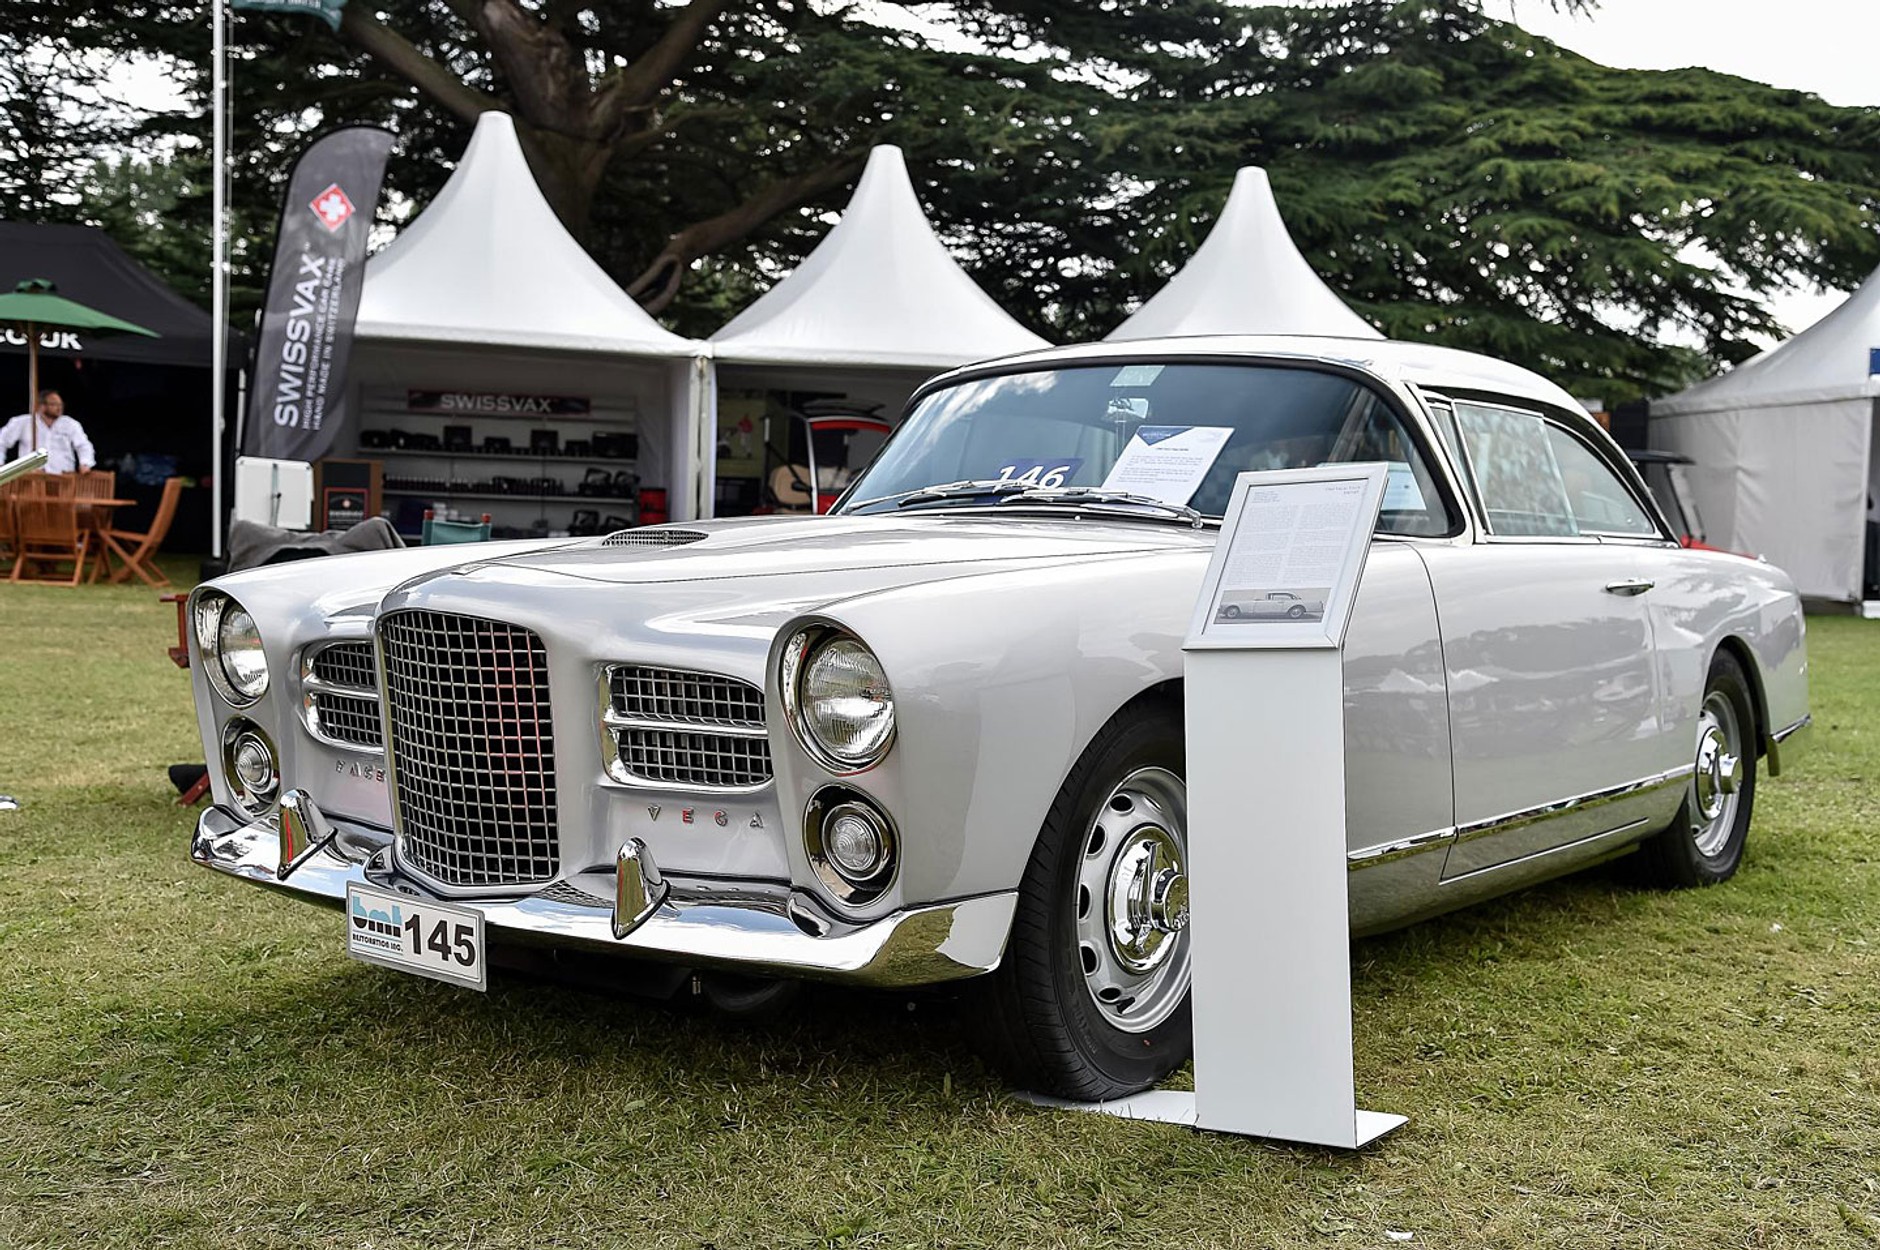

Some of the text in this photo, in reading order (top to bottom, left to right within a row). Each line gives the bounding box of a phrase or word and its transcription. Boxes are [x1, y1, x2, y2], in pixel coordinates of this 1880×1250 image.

[318, 288, 329, 313] CAR
[274, 253, 326, 428] SWISSVAX
[305, 314, 326, 398] PERFORMANCE
[313, 258, 345, 430] HAND MADE IN SWITZERLAND
[302, 399, 313, 430] HIGH
[441, 393, 552, 412] SWISSVAX
[992, 465, 1071, 492] 146
[647, 803, 763, 828] VEGA
[404, 913, 476, 967] 145
